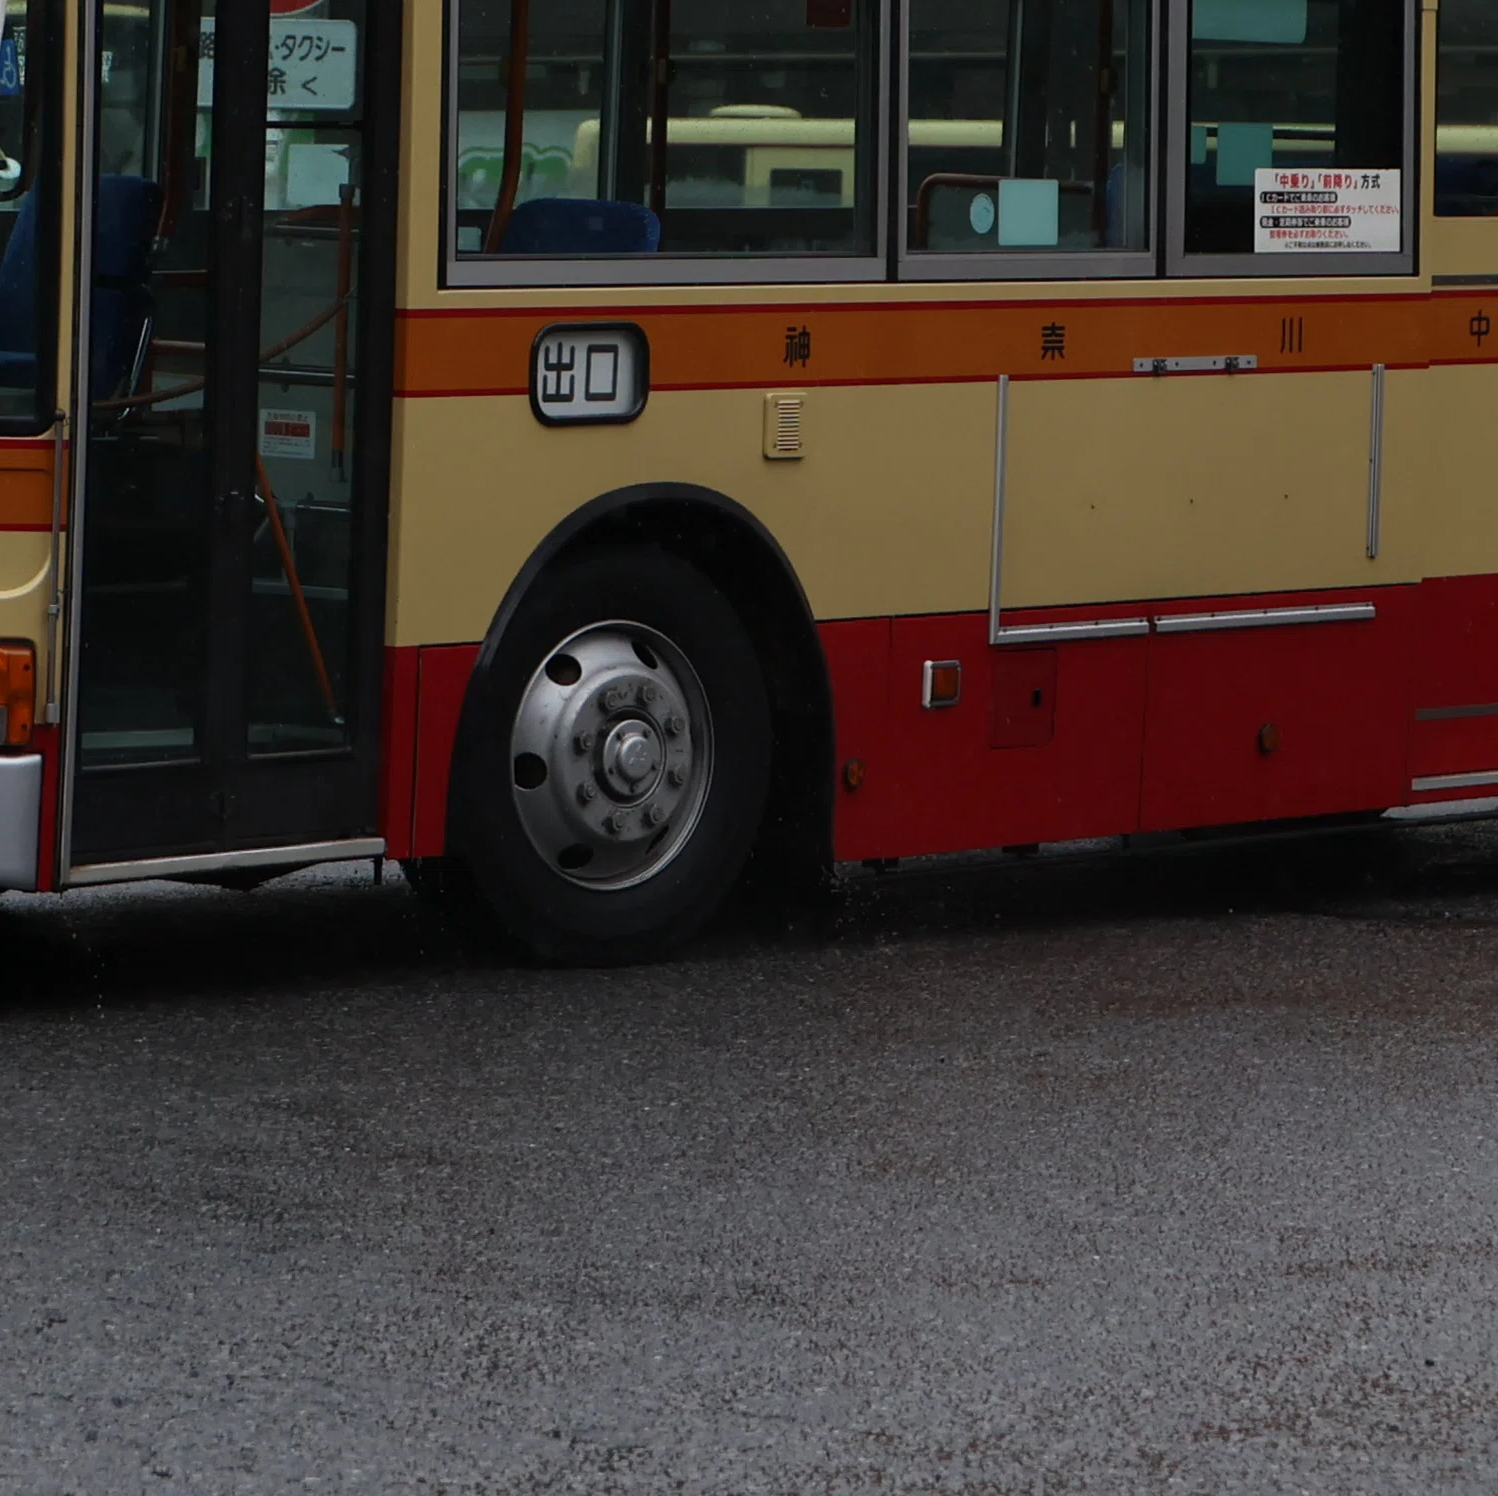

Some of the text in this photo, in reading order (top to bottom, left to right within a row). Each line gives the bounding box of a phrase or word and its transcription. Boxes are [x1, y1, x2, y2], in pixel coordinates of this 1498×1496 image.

[782, 324, 811, 369] 神
[1280, 316, 1303, 354] 川
[1469, 309, 1491, 348] 中
[542, 341, 619, 403] 出口
